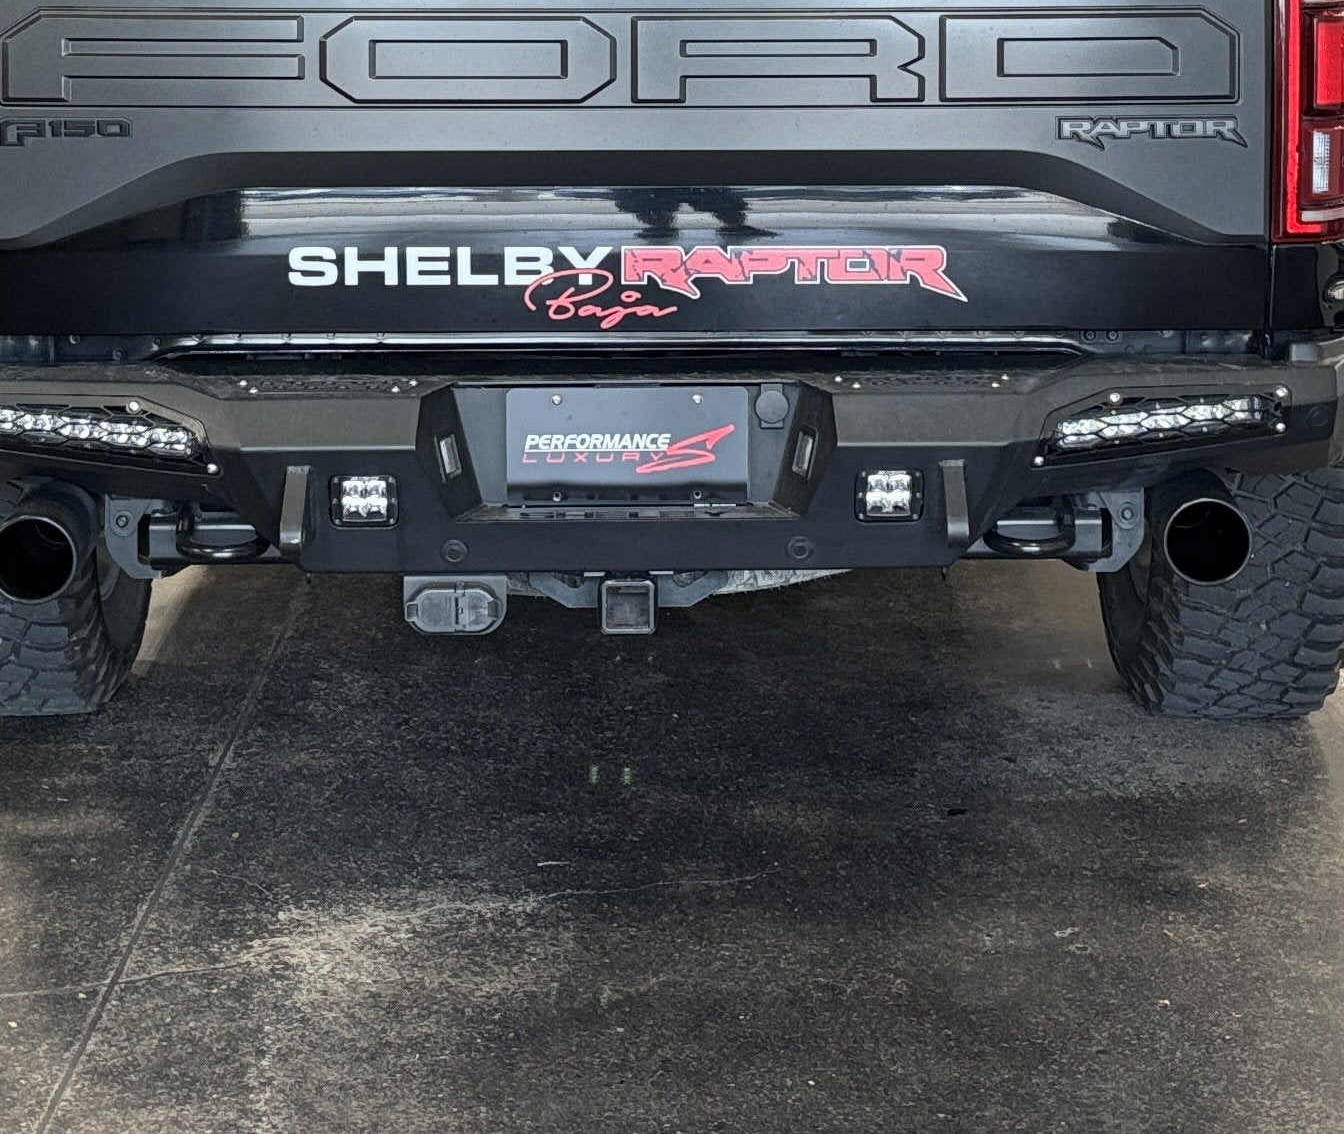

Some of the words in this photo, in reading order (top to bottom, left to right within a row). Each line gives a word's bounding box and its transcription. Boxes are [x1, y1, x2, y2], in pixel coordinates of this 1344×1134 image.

[1057, 116, 1249, 151] RAPTOR
[287, 245, 614, 286] SHELBY
[621, 245, 969, 301] RAPTOR
[524, 267, 678, 329] Baja
[521, 452, 664, 464] LUXURY
[524, 433, 671, 450] PERFORMANCE
